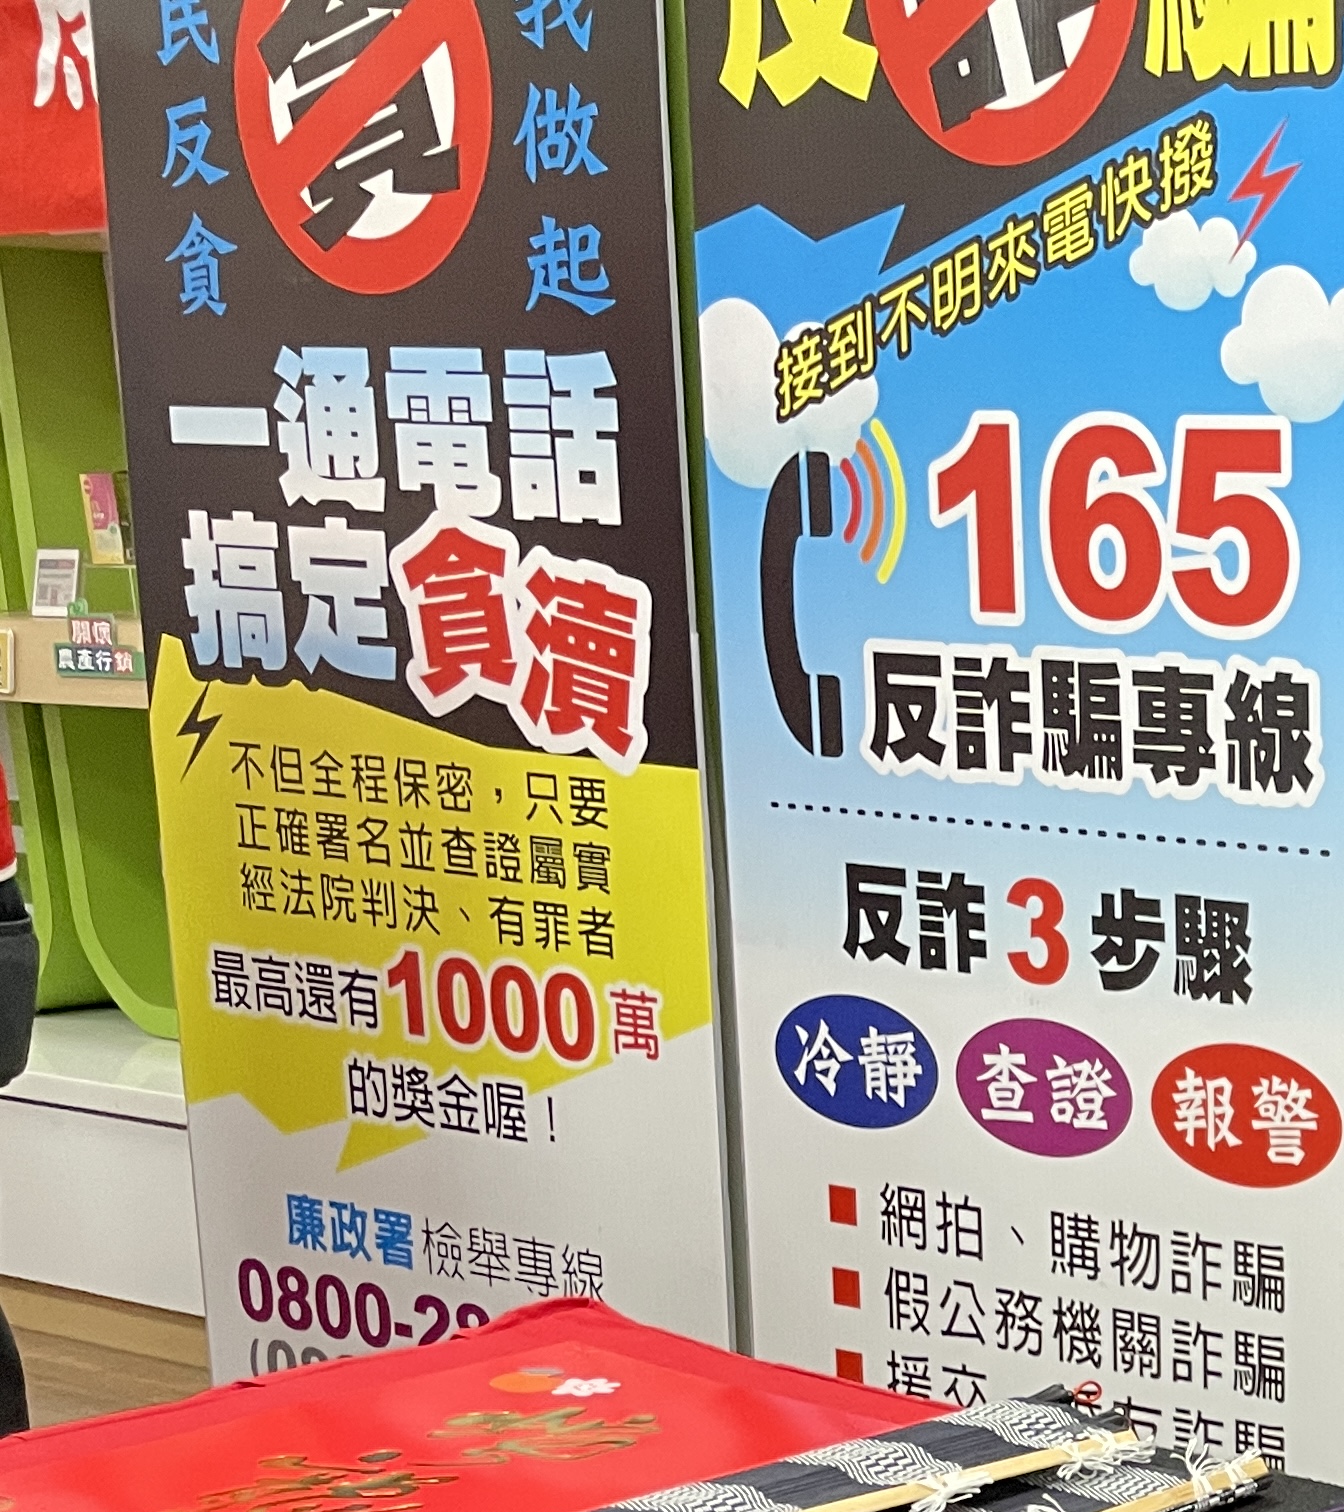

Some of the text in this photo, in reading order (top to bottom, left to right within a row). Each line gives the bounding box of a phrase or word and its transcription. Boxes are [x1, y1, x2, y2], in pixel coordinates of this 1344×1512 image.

[777, 118, 1218, 420] 接到不明來電快撥
[168, 346, 622, 525] 一通電話
[932, 416, 1298, 634] 165
[181, 510, 650, 770] 搞定貪瀆
[228, 741, 610, 831] 不但全程保密，只要
[868, 650, 1314, 794] 反詐騙專線
[234, 802, 612, 895] 正確署名並查證屬實
[239, 861, 616, 960] 經法院判決、有罪者
[347, 1057, 558, 1144] 的獎金喔！
[795, 1017, 1319, 1166] 冷靜 查證 報警
[879, 1181, 1286, 1314] 網拍、購物詐騙
[883, 1266, 1286, 1404] 假公務機關詐騙
